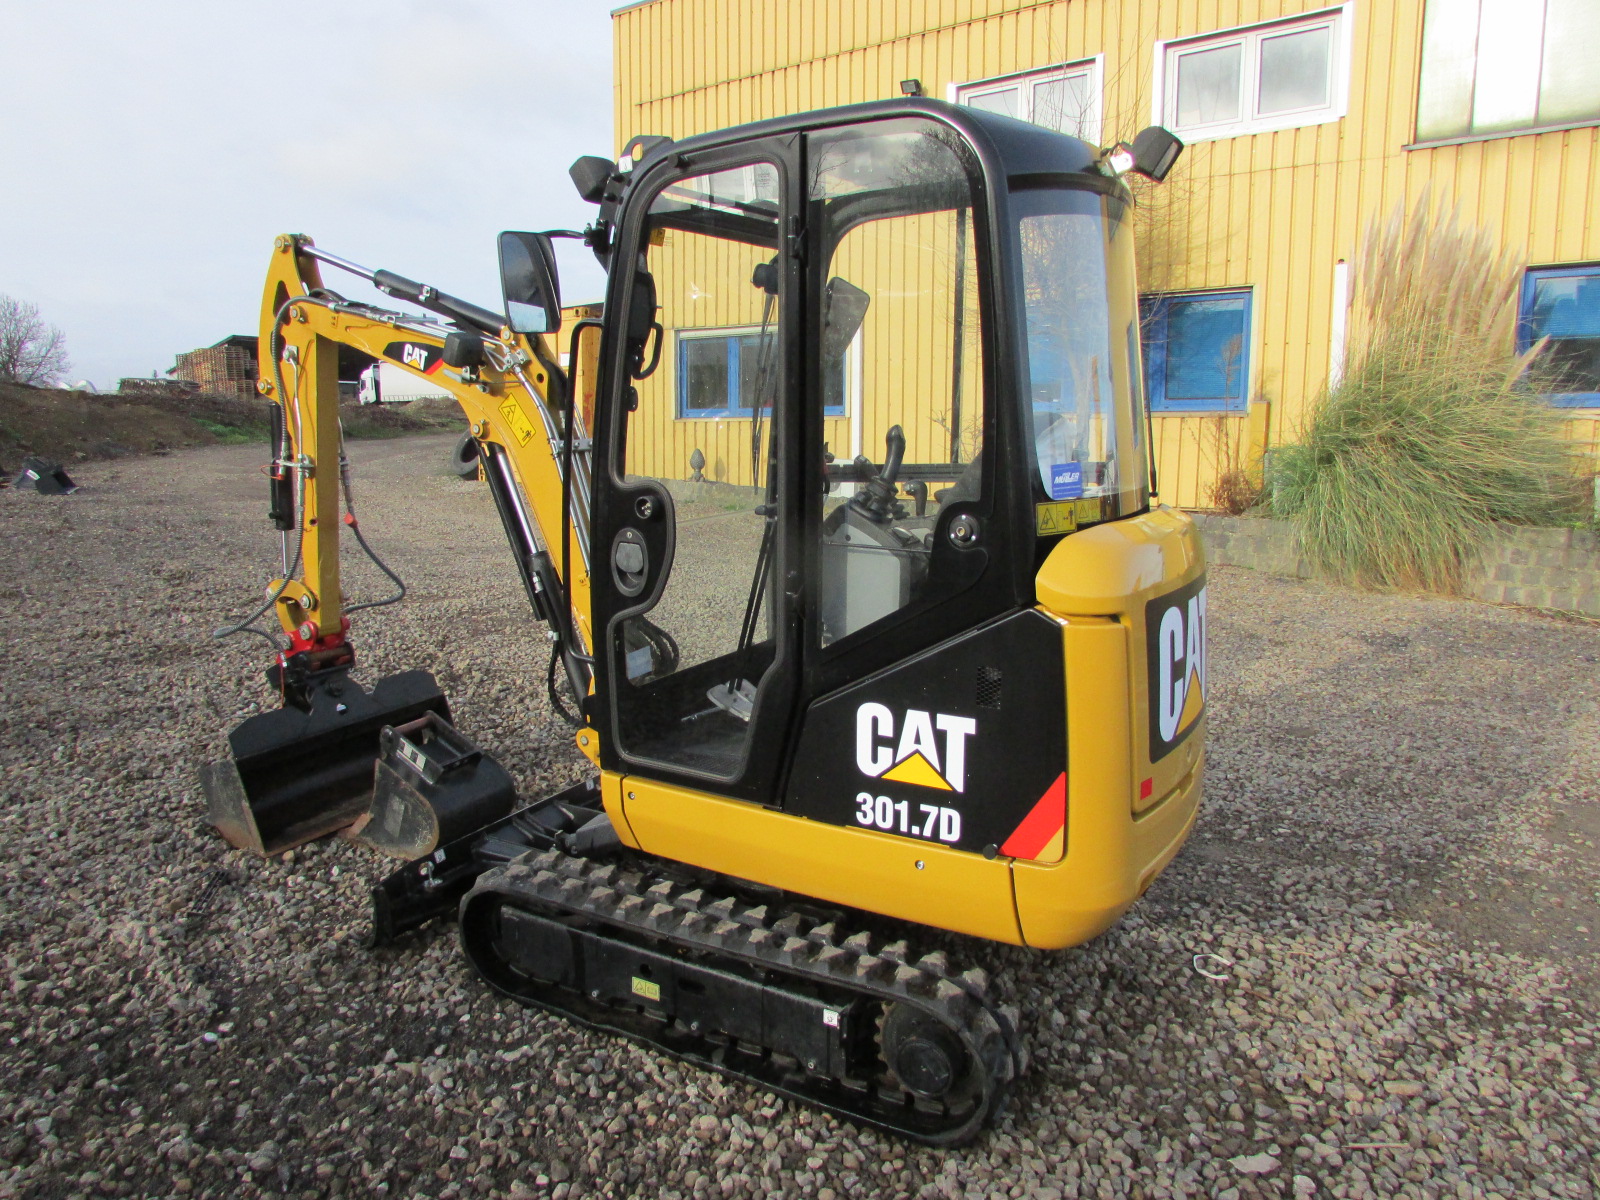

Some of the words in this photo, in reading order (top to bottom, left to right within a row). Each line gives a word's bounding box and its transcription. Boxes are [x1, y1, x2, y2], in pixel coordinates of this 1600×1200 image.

[403, 344, 428, 370] CAT
[1159, 585, 1207, 742] CAT
[857, 702, 976, 793] CAT
[856, 792, 961, 842] 301.7D
